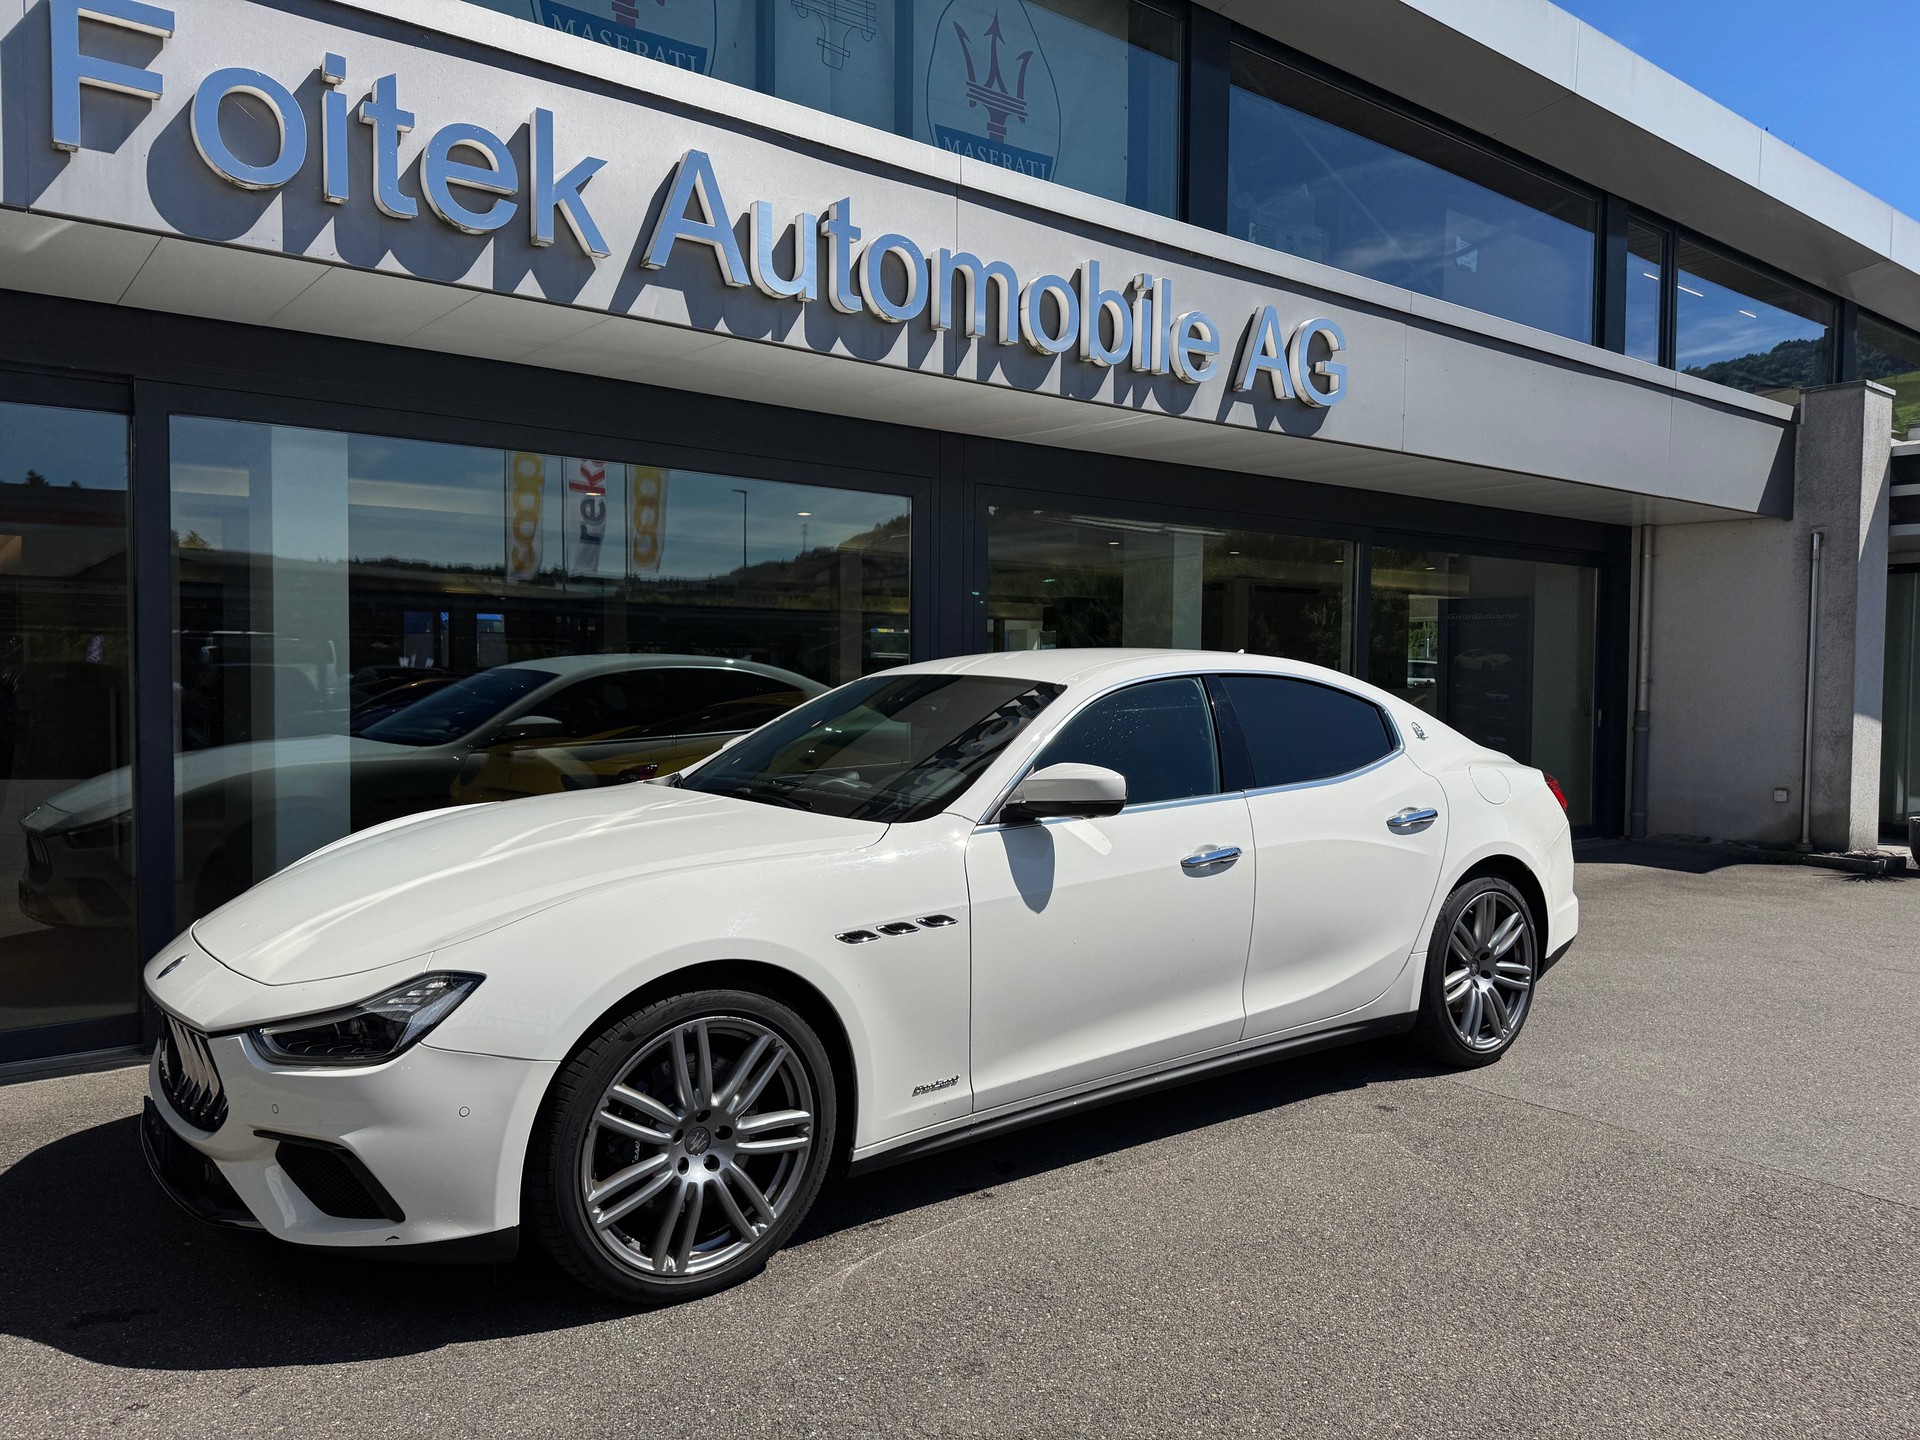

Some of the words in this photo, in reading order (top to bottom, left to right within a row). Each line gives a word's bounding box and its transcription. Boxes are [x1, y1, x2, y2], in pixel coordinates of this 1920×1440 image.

[551, 14, 698, 72] MASERATI
[943, 136, 1047, 181] MASERATI
[50, 0, 610, 260] Foitek
[641, 149, 1221, 385] Automobile
[1233, 305, 1348, 408] AG
[568, 458, 606, 545] rek
